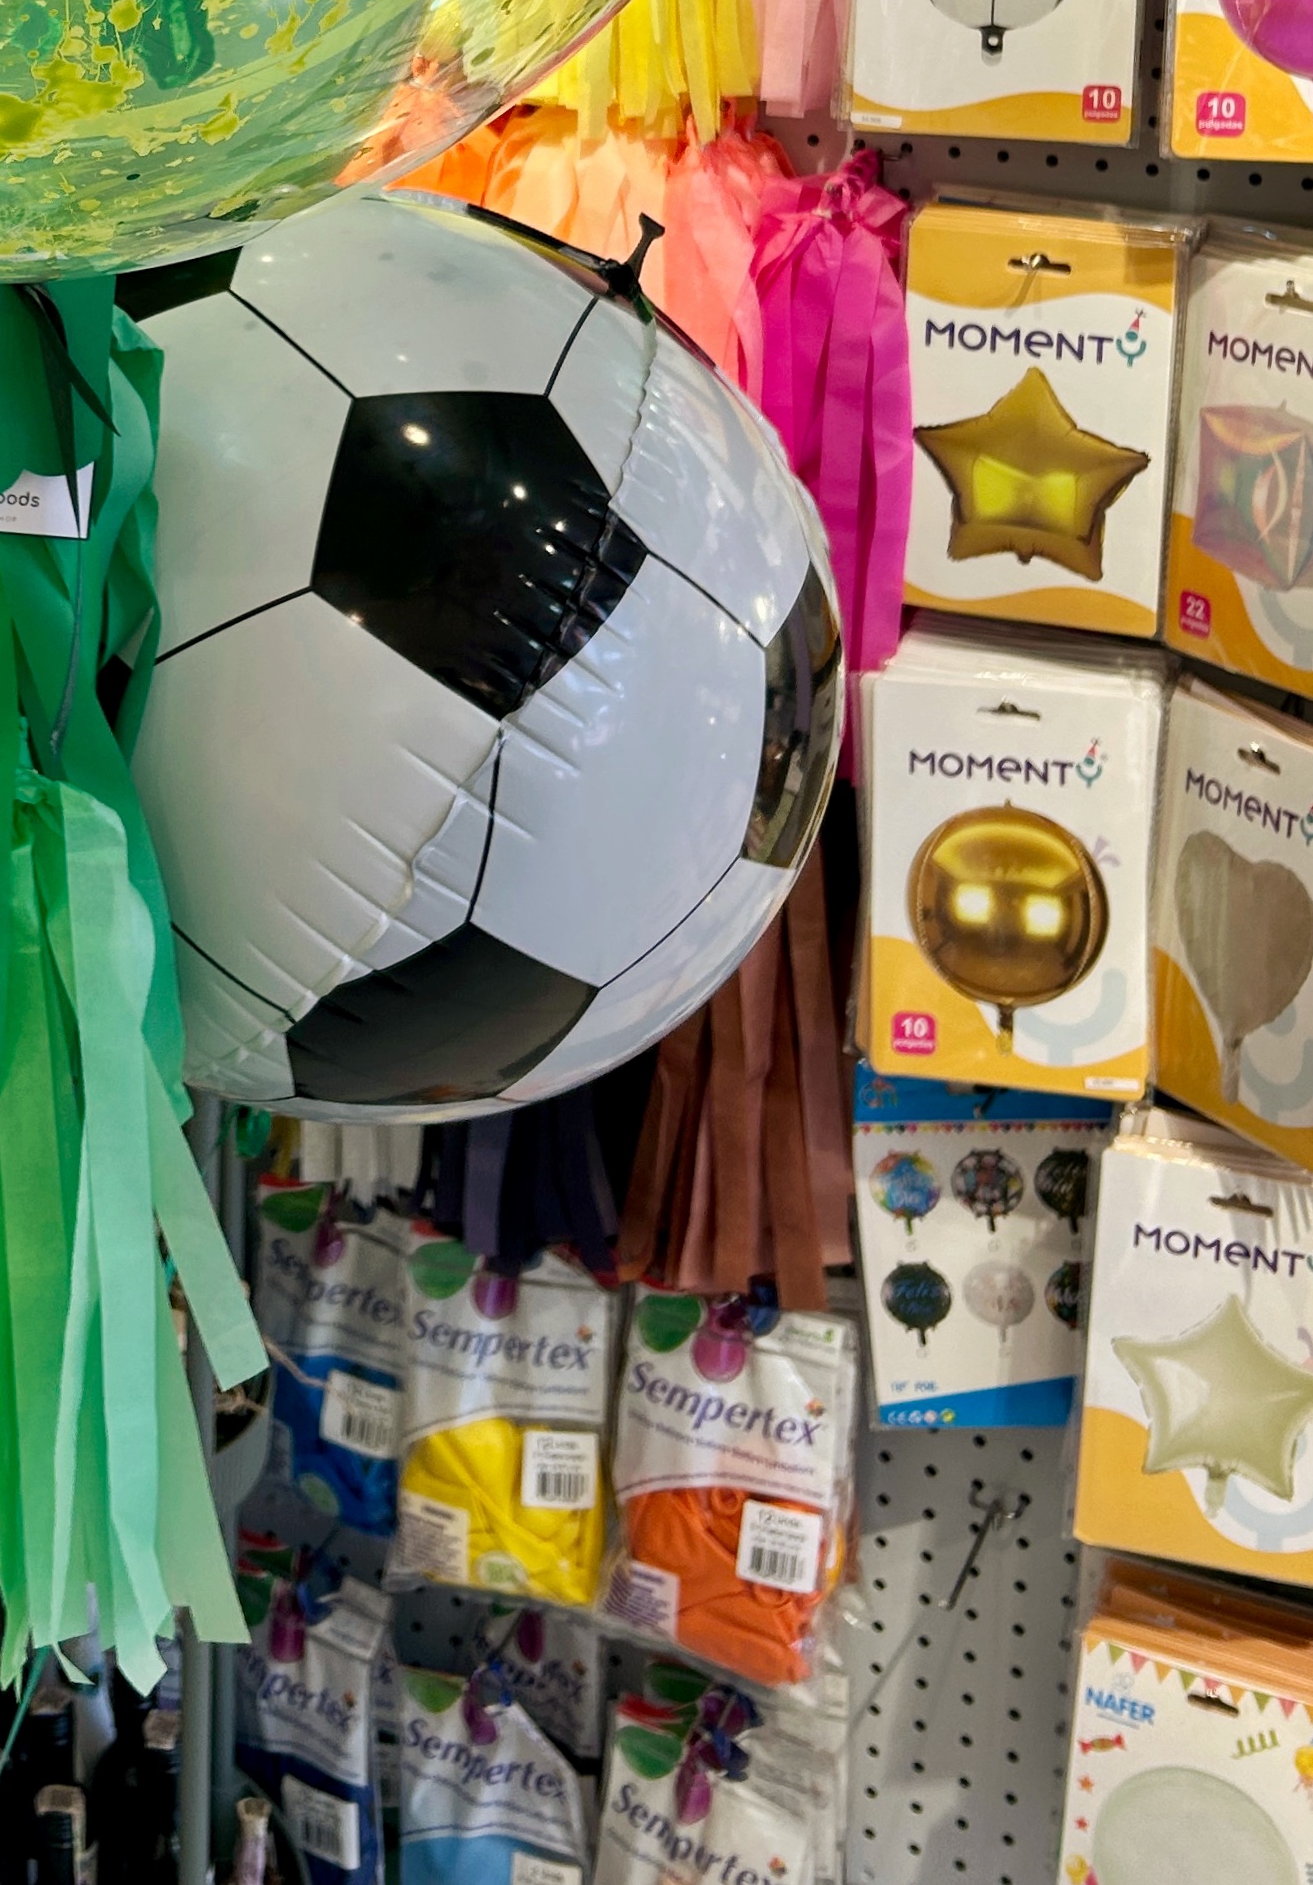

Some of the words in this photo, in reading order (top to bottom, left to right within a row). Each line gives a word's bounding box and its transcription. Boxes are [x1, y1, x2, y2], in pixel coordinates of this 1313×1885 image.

[1089, 88, 1116, 110] 10
[1207, 96, 1236, 119] 10
[1186, 595, 1206, 621] 22
[901, 1016, 929, 1038] 10
[408, 1310, 593, 1372] Sempertex
[627, 1361, 822, 1446] Sempertex
[1085, 1686, 1155, 1726] NAFER
[404, 1718, 567, 1805] Sempertex
